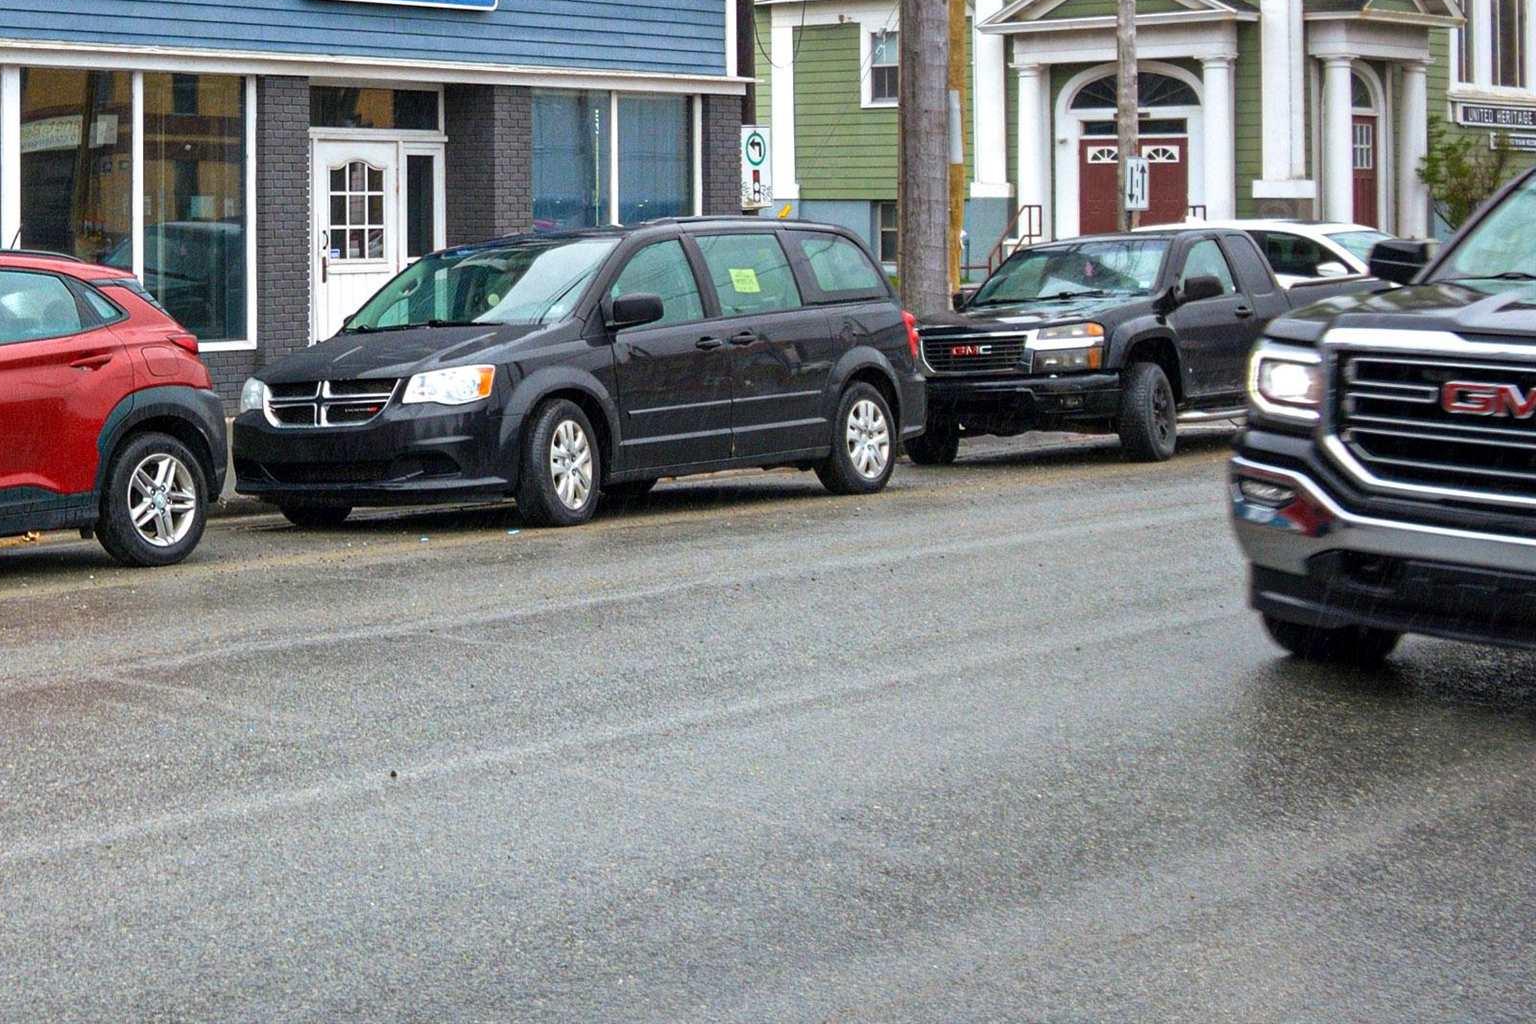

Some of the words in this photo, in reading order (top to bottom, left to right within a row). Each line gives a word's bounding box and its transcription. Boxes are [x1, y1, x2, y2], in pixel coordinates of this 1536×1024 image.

[1467, 108, 1494, 123] UNITED
[1496, 109, 1533, 125] HERITAGE
[952, 344, 993, 355] GMC
